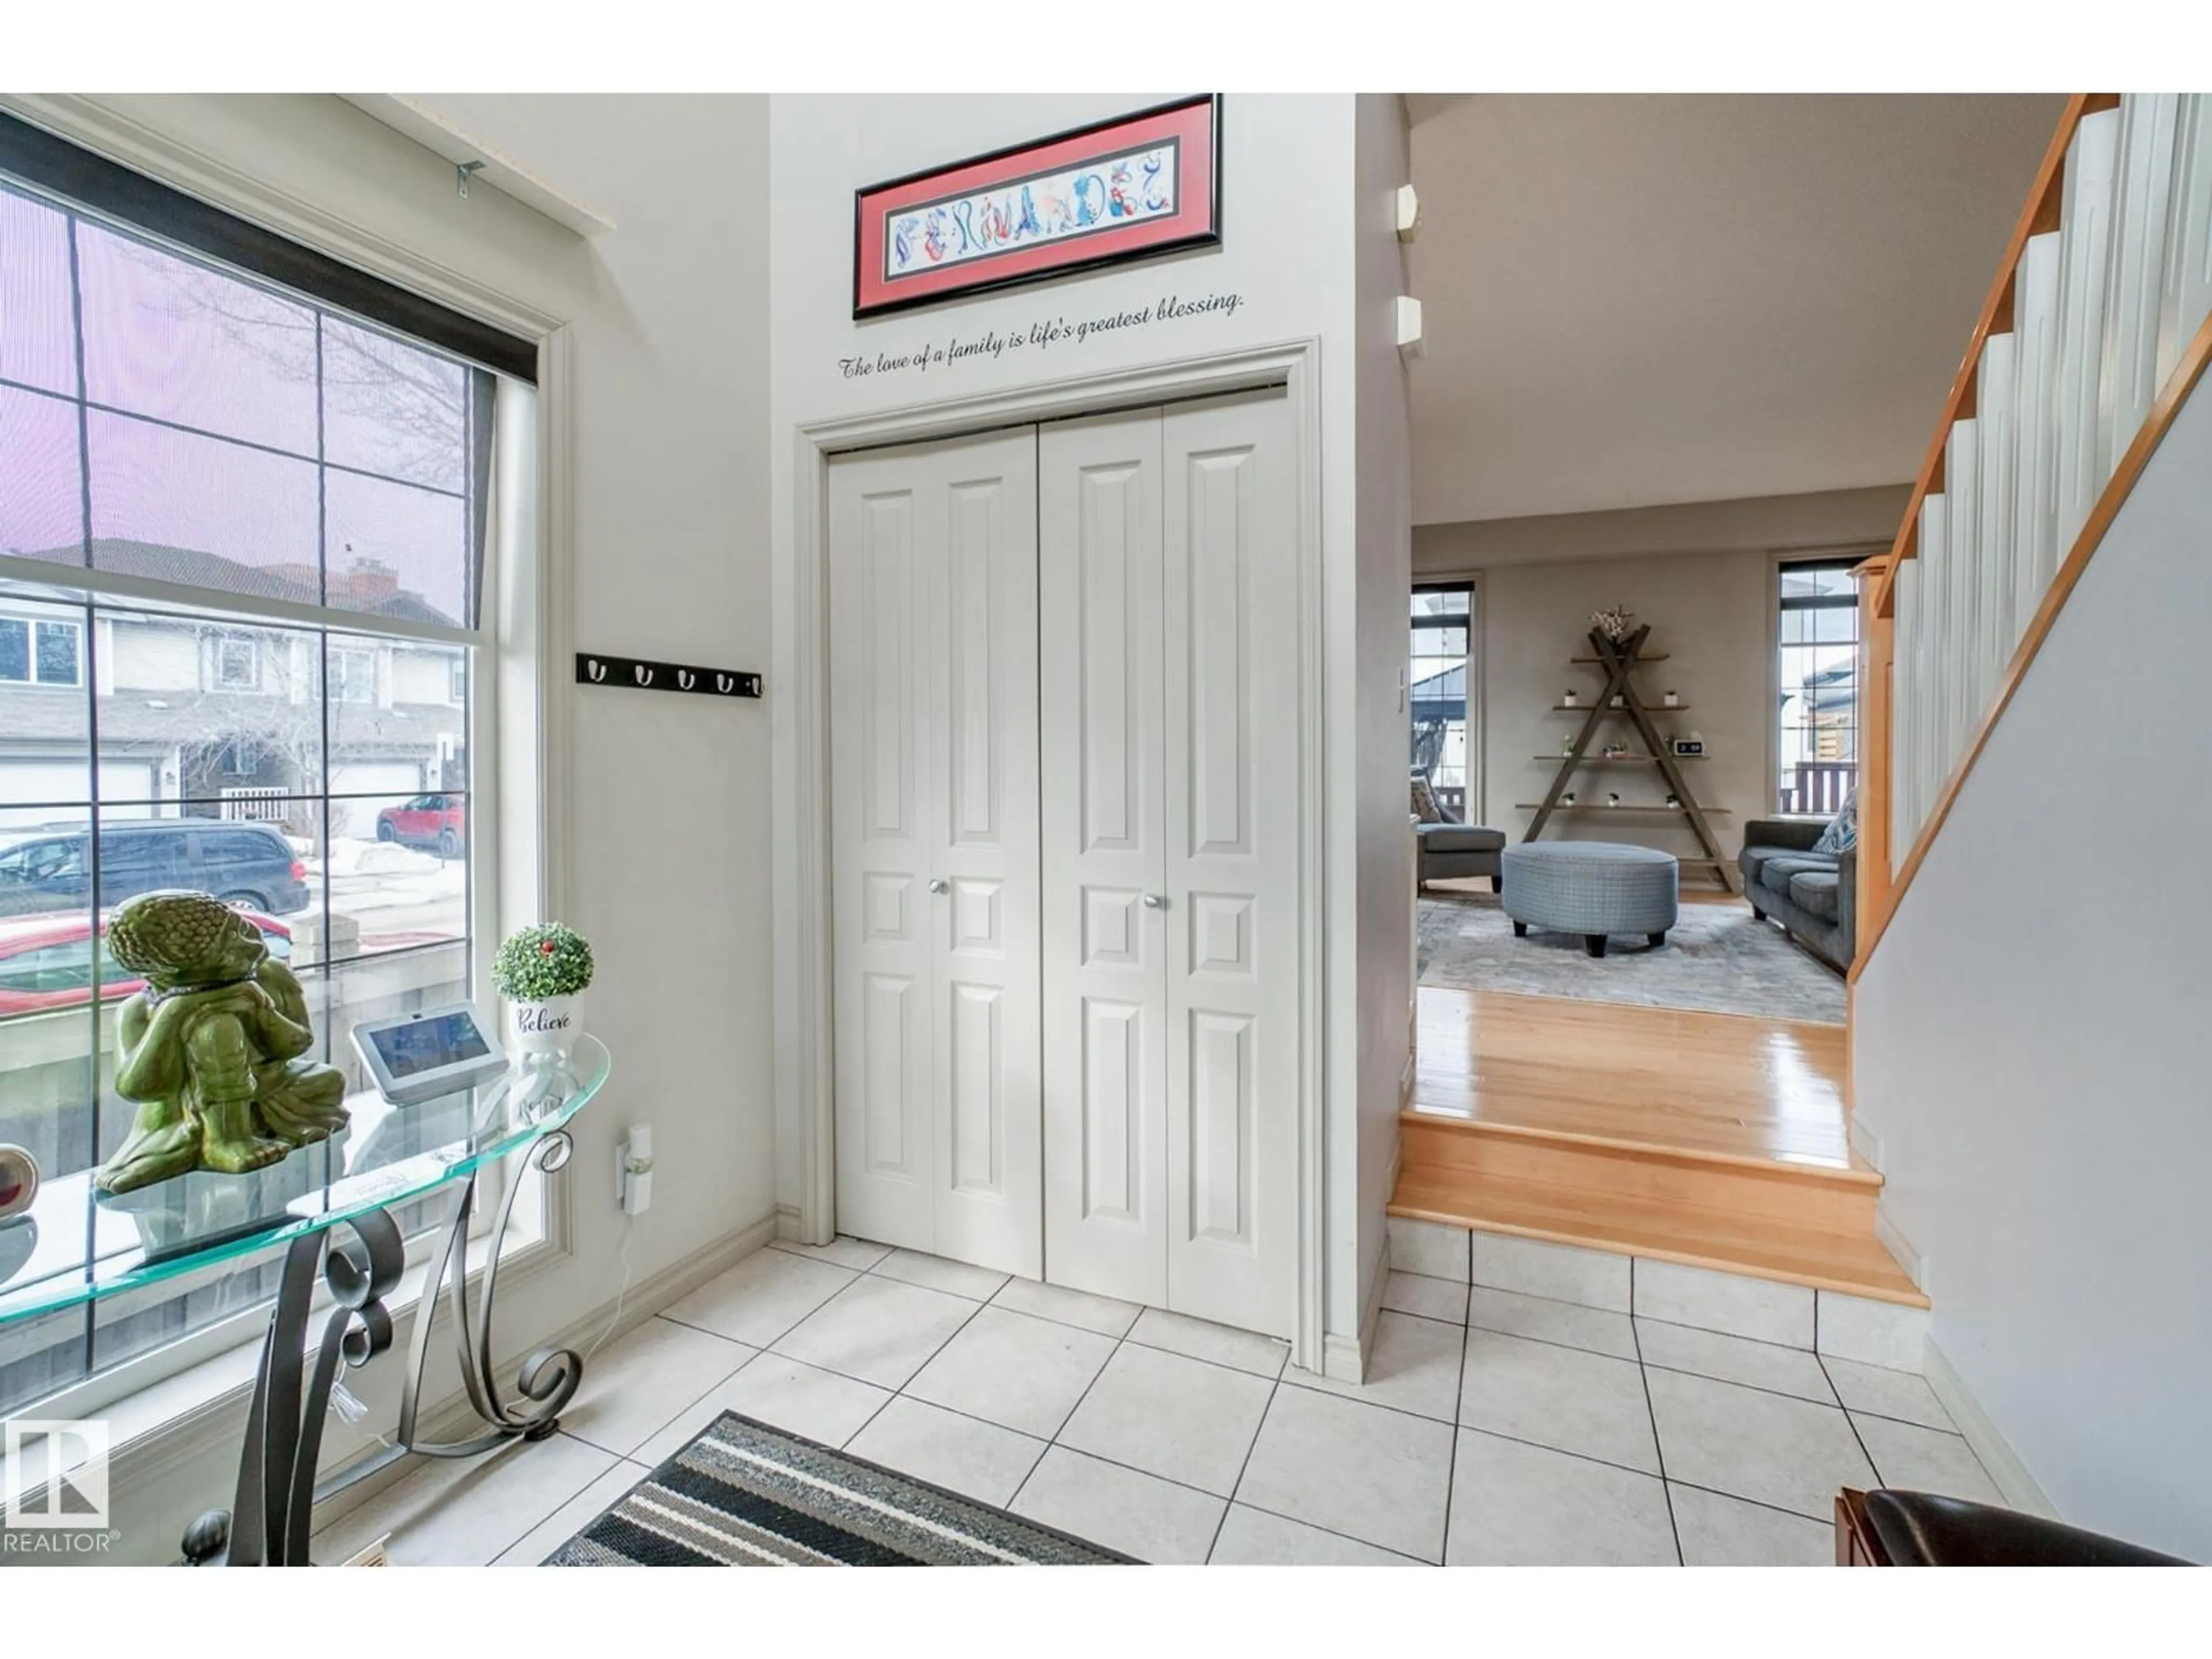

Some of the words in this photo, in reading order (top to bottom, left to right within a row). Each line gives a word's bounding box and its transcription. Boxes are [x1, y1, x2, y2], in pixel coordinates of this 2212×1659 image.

[839, 357, 873, 378] The
[877, 353, 910, 373] love
[912, 344, 931, 372] of
[934, 351, 945, 362] a
[947, 331, 1004, 366] family
[1008, 332, 1026, 348] is
[1029, 317, 1075, 349] life's
[1077, 307, 1152, 343] greatest
[1156, 293, 1243, 321] blessing.
[517, 1007, 571, 1033] Believe
